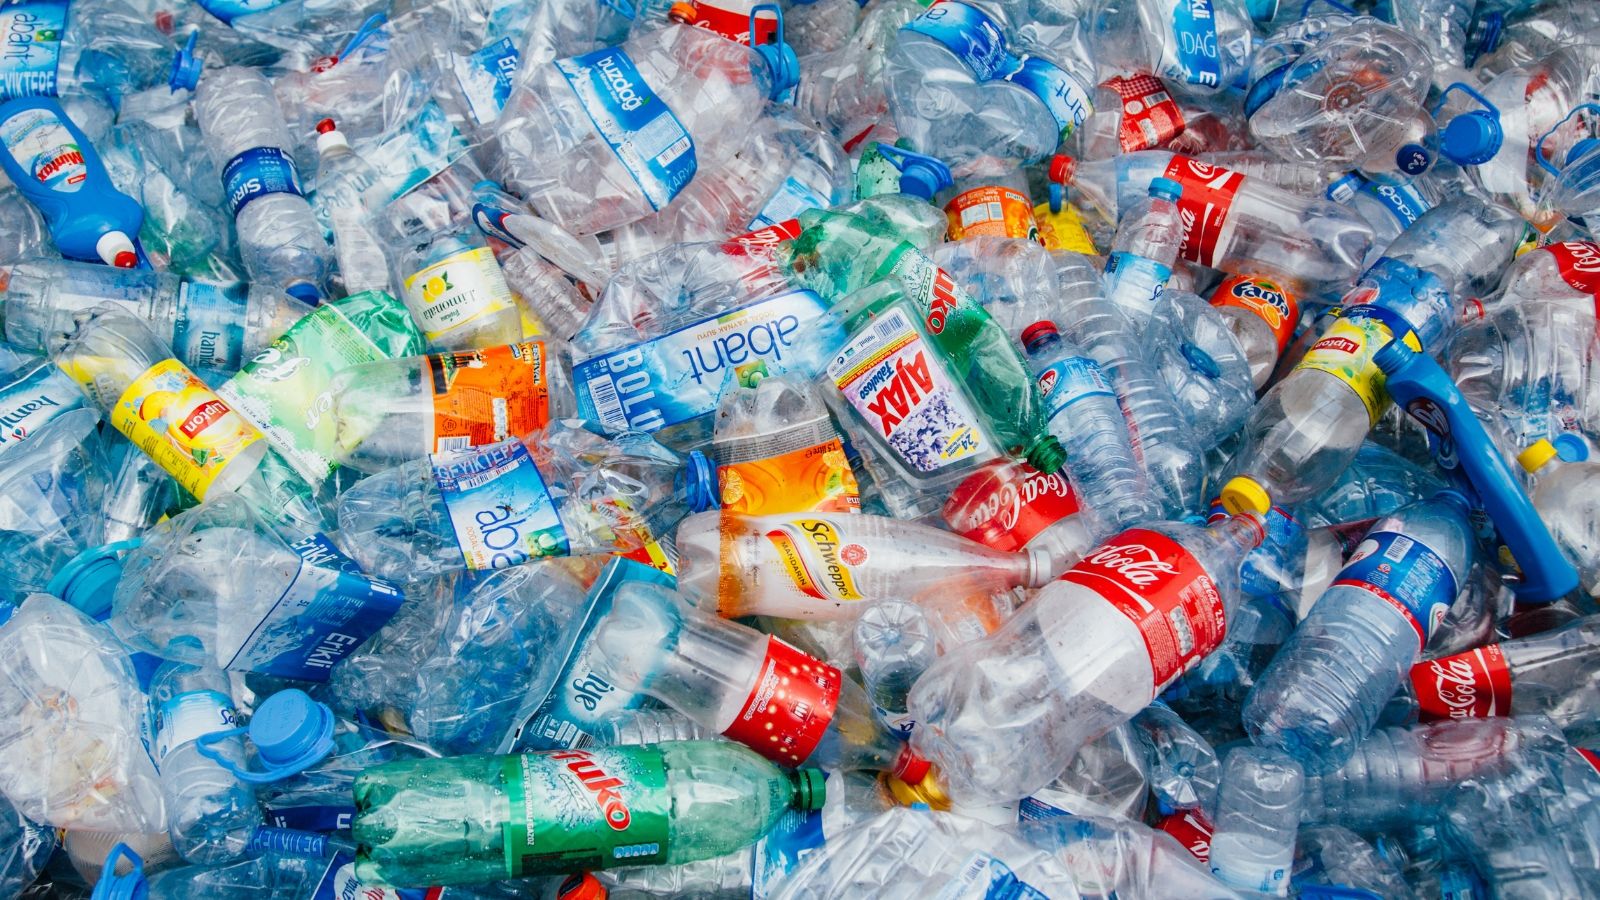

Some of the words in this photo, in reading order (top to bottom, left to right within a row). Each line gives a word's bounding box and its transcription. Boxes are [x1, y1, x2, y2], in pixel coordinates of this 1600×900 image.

[5, 13, 38, 61] abant
[596, 55, 644, 112] buzdağı
[37, 151, 84, 182] Mintax
[1376, 183, 1417, 224] zdağı
[926, 266, 957, 336] uko
[1231, 280, 1290, 318] Fanta
[682, 315, 799, 385] abant
[606, 348, 667, 432] BOLU
[858, 360, 895, 400] Fabuloso
[866, 349, 935, 438] AJAX
[185, 401, 230, 438] Lipton
[780, 541, 808, 587] MANDARIN
[802, 520, 849, 598] Schweppes
[304, 631, 356, 670] Erikli
